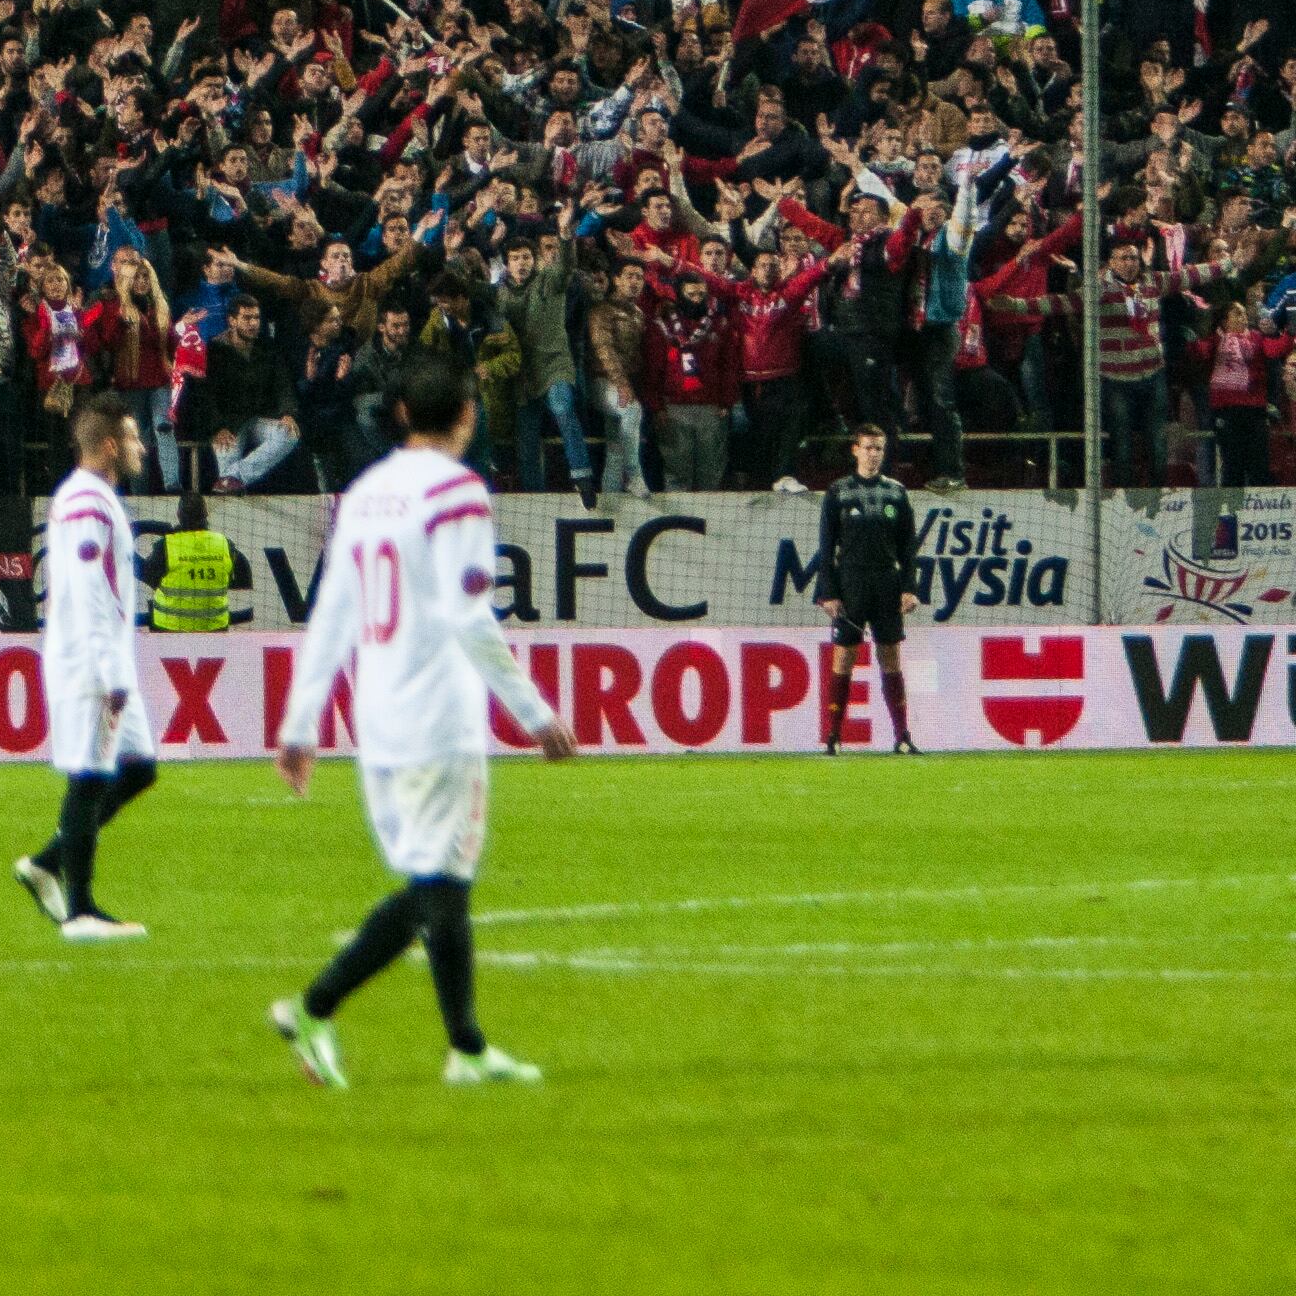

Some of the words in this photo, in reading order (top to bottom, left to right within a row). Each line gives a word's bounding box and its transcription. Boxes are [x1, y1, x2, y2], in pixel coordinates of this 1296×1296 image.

[1241, 522, 1293, 541] 2015
[188, 569, 216, 580] 113
[351, 537, 401, 645] 10
[769, 538, 1069, 622] Maysia
